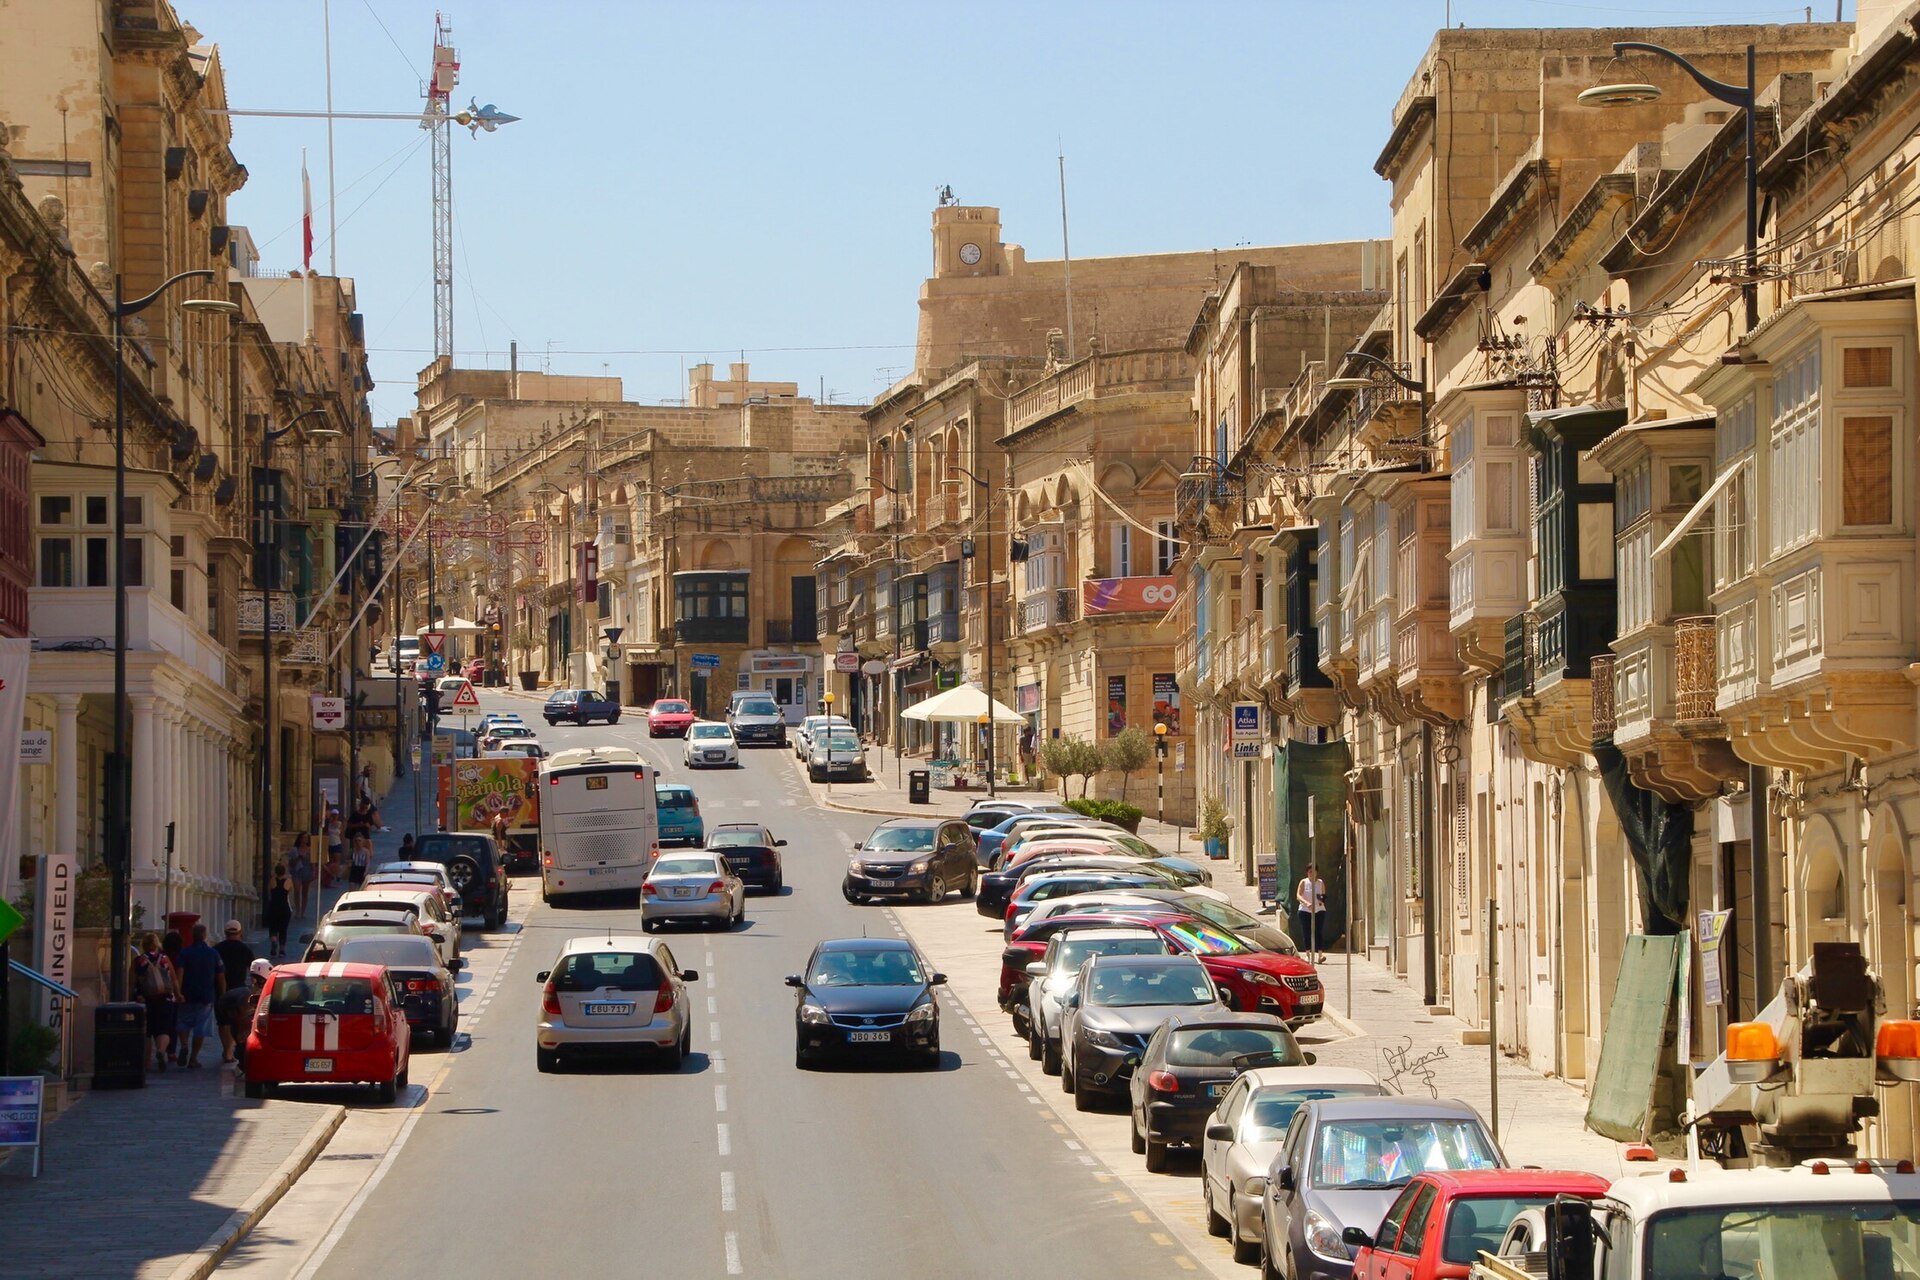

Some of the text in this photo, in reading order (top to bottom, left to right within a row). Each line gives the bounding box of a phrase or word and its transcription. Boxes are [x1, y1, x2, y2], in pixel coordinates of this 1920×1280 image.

[1142, 584, 1177, 604] GO
[37, 738, 47, 746] de
[1235, 742, 1260, 752] Links
[591, 1005, 627, 1013] EBU 717
